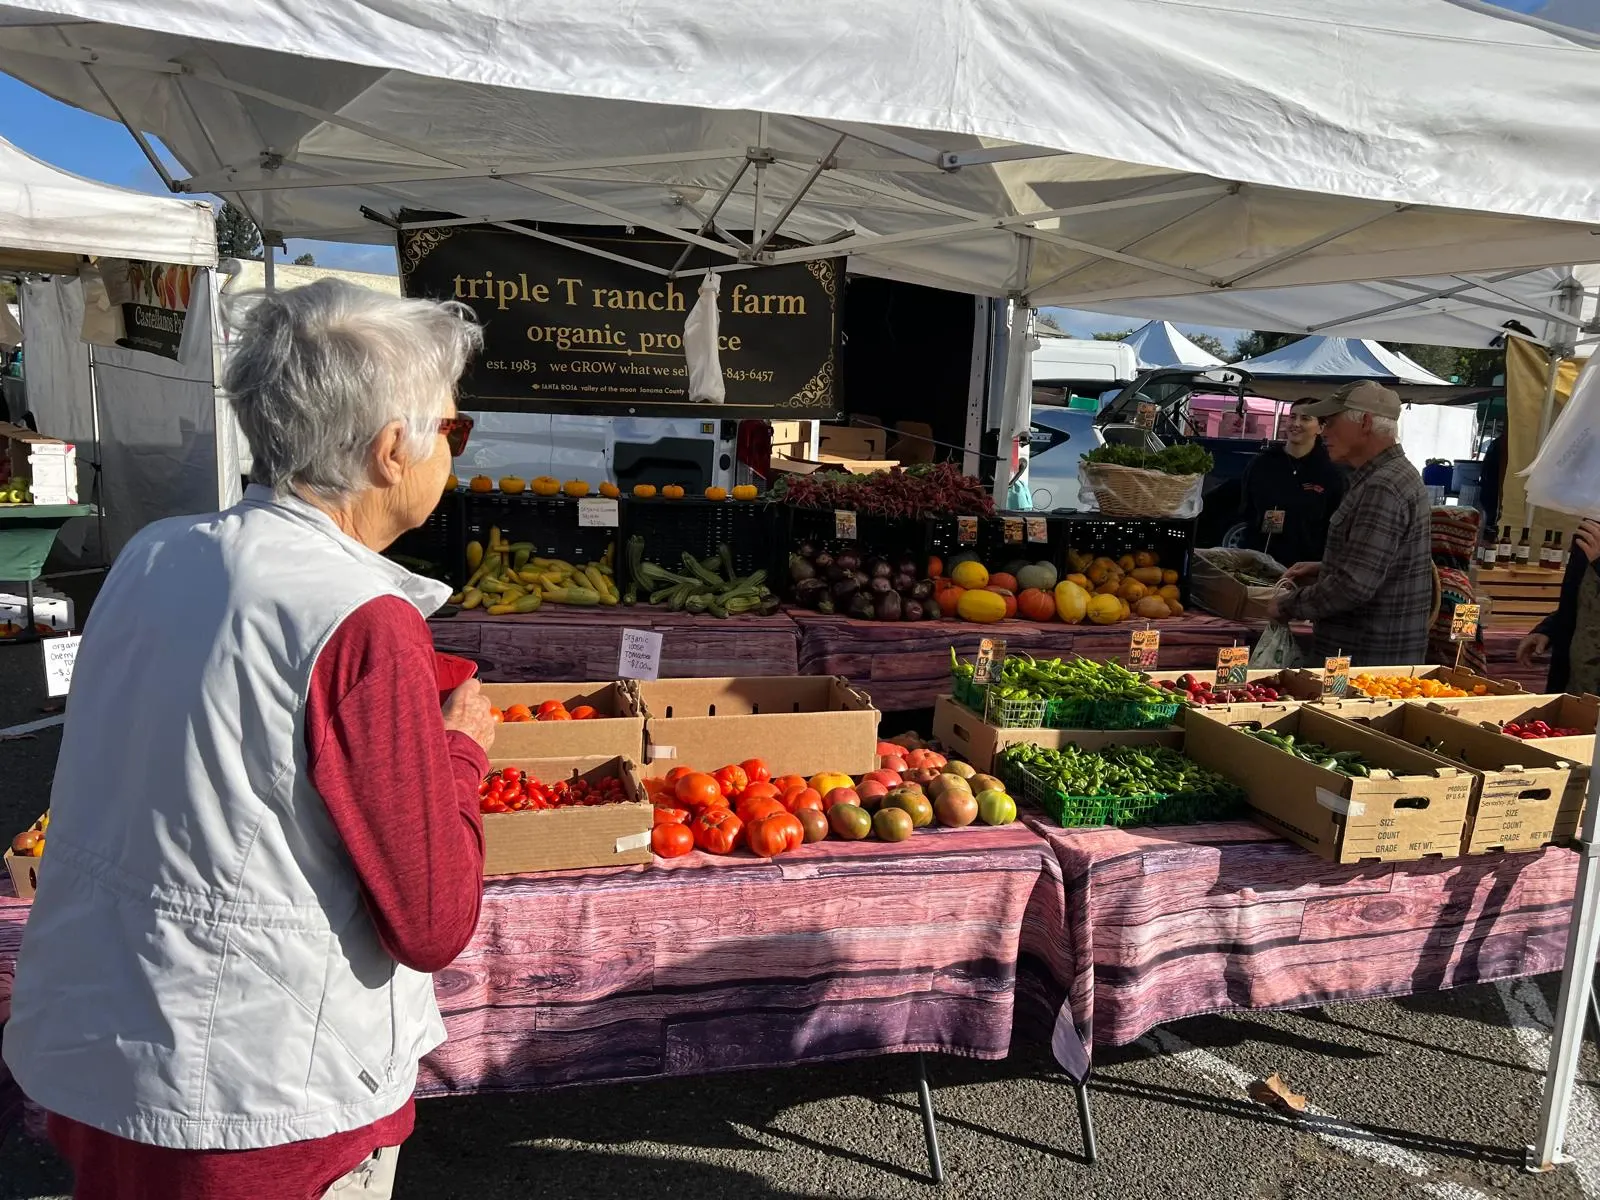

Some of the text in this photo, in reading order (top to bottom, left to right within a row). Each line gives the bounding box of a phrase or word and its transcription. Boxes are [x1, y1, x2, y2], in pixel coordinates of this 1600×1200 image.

[452, 271, 550, 310] triple
[557, 278, 584, 306] T
[592, 282, 686, 312] ranch
[732, 284, 807, 315] farm
[526, 324, 742, 352] organic proce
[486, 360, 508, 370] est.
[511, 360, 536, 374] 1983
[550, 363, 568, 372] we
[570, 361, 616, 373] GROW
[620, 362, 650, 375] what
[654, 366, 670, 376] we
[672, 365, 688, 377] sel
[580, 384, 598, 392] valley
[664, 387, 684, 395] County
[1218, 667, 1230, 677] $10
[1505, 808, 1519, 817] SIZE
[1380, 818, 1396, 826] SIZE
[1502, 820, 1523, 830] COUNT
[1378, 830, 1400, 840] COUNT
[1500, 834, 1520, 842] GRADE
[1530, 832, 1542, 840] NET
[1376, 844, 1398, 853] GRADE
[1408, 842, 1421, 850] NET
